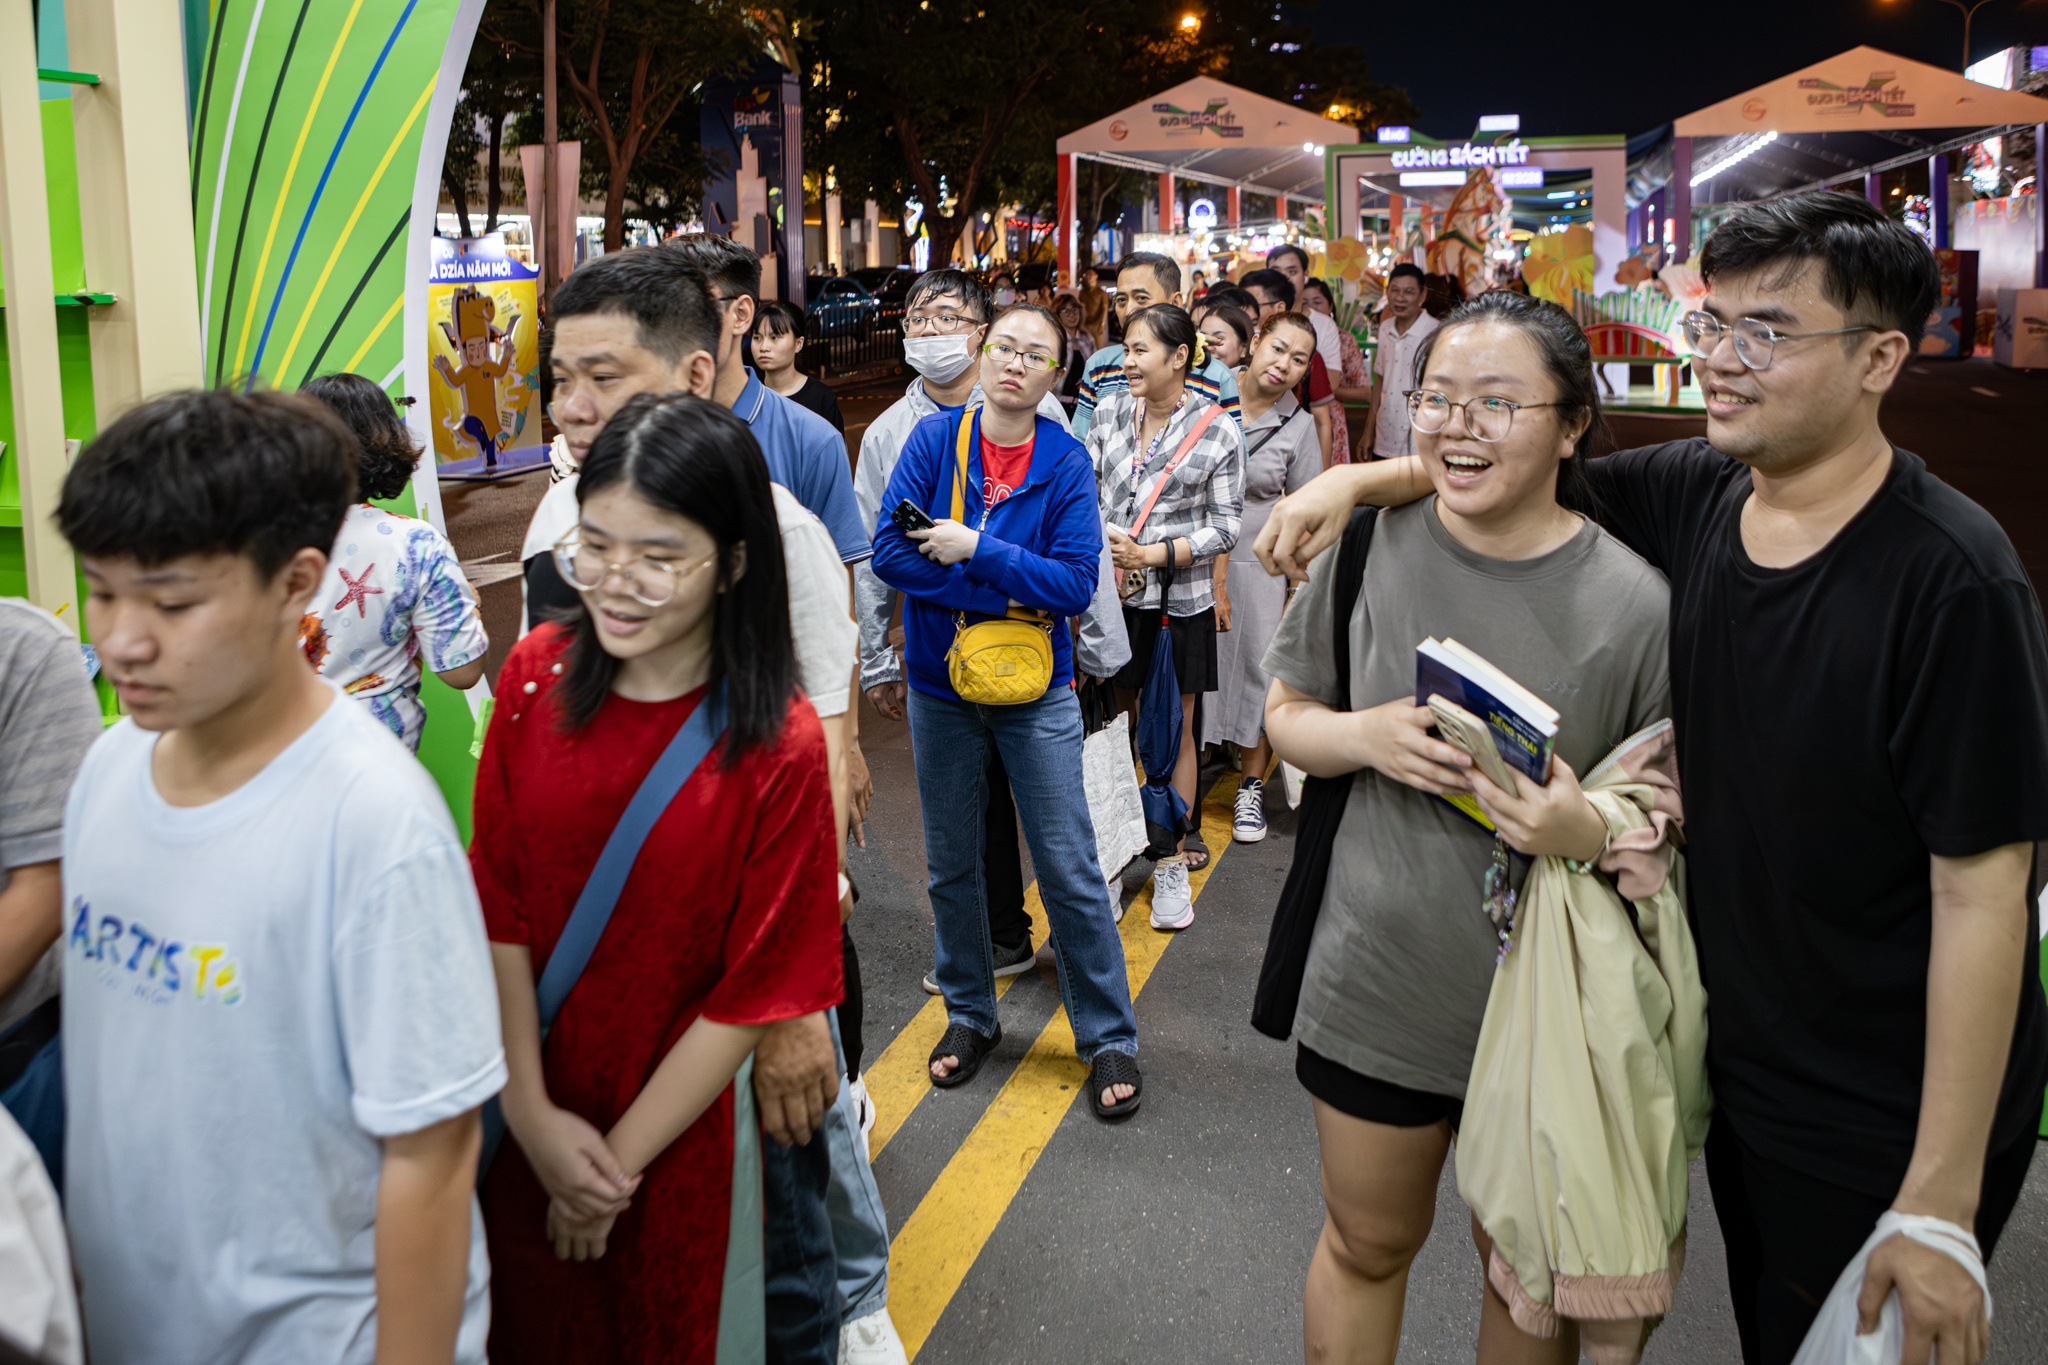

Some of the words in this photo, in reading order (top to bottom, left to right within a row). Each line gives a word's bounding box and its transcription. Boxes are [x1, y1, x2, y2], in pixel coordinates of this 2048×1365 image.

[734, 110, 771, 126] Bank
[1449, 142, 1496, 166] SÁCH
[1496, 138, 1530, 164] TẾT
[440, 260, 465, 279] DZÍA
[467, 259, 490, 278] NĂM
[1488, 710, 1515, 738] TIẾNG
